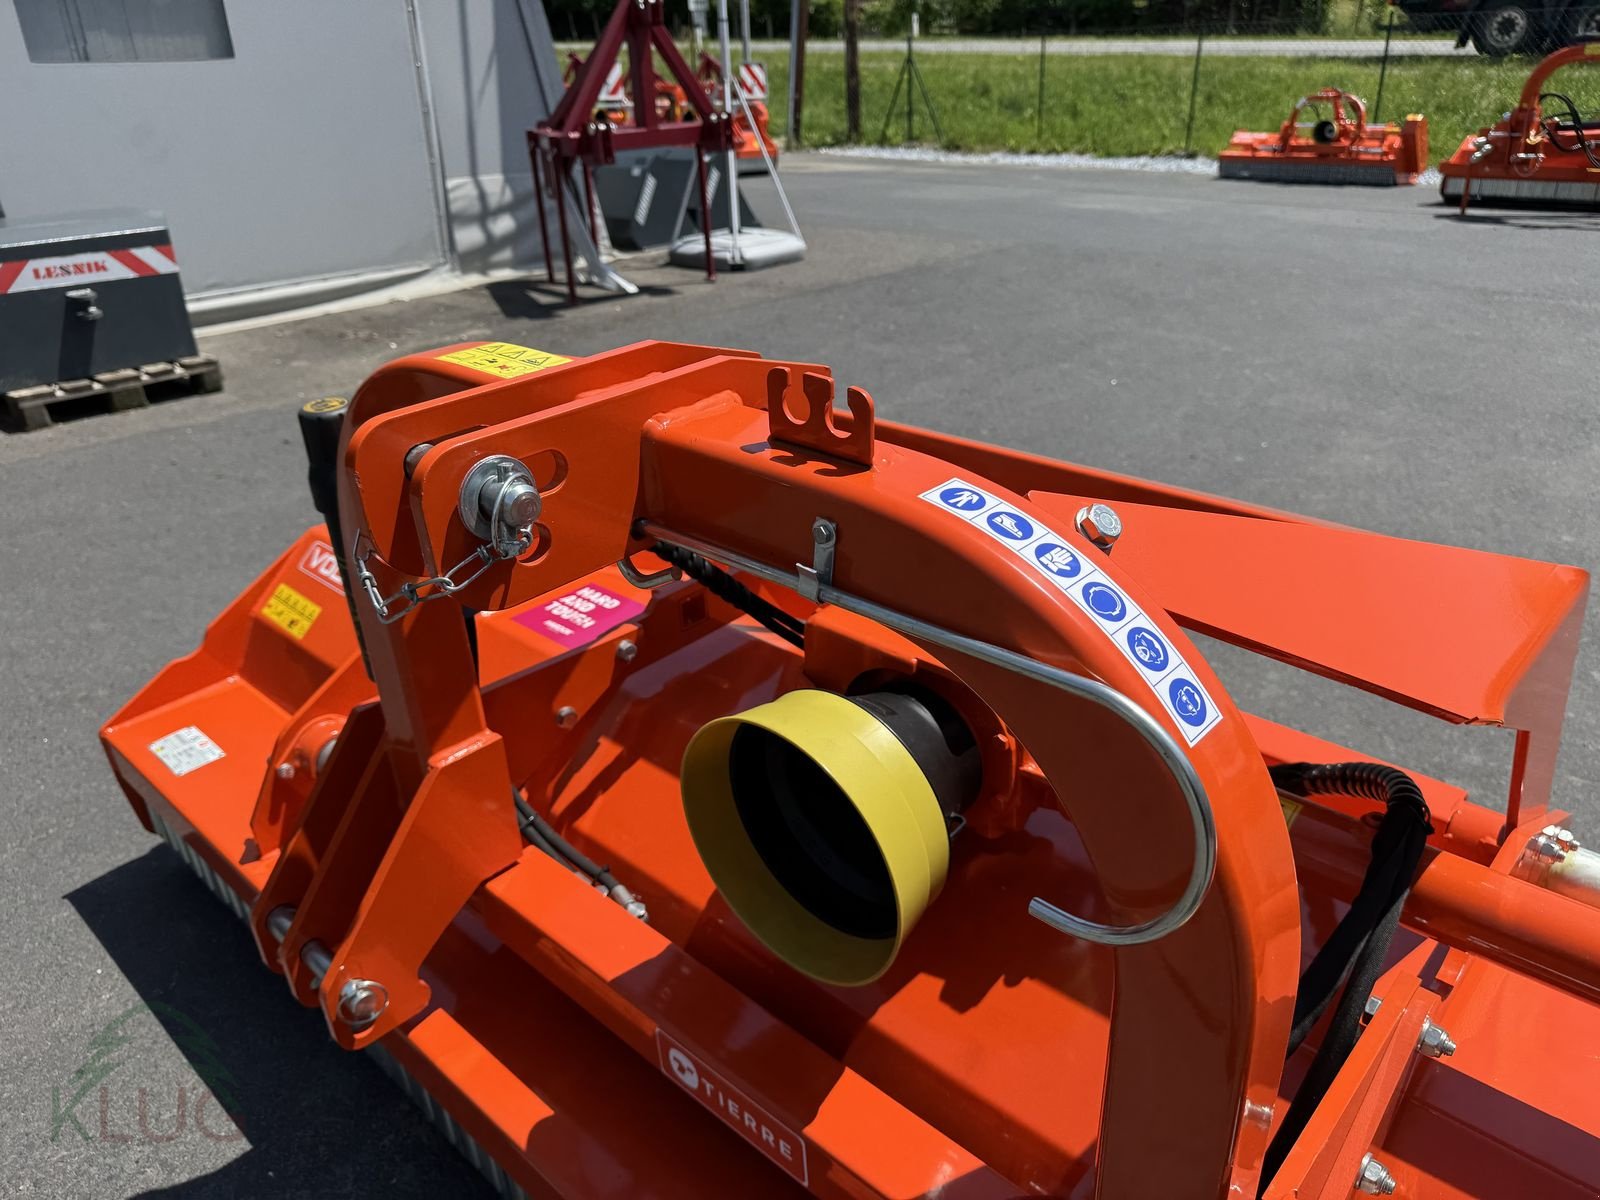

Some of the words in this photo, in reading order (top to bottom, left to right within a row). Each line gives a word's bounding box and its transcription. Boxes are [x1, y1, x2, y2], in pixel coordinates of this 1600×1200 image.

[559, 595, 596, 613] AND
[576, 587, 620, 609] HARD
[544, 600, 596, 629] TOUGH
[701, 1077, 793, 1161] TIERRE
